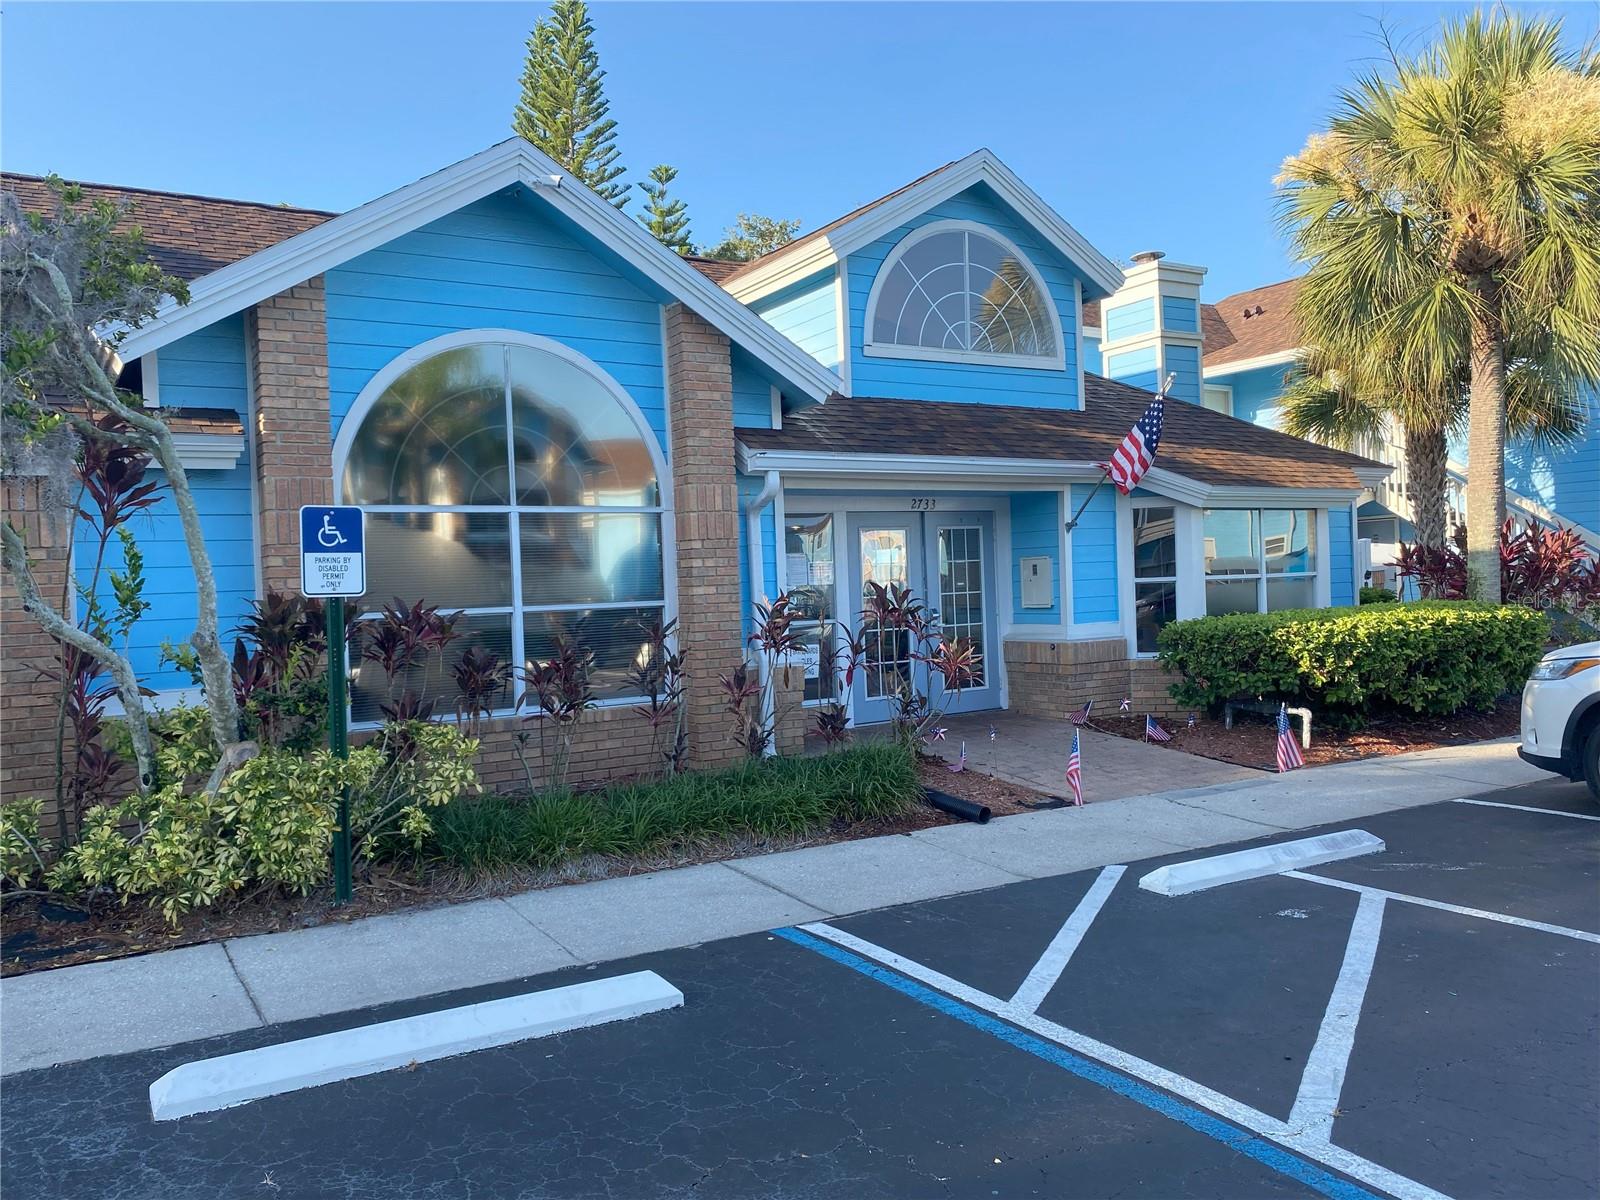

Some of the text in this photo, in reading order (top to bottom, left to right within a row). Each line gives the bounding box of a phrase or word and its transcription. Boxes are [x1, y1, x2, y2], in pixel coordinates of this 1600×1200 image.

[911, 498, 936, 510] 2733
[315, 556, 341, 564] PARKING
[318, 564, 349, 572] DISABLED
[322, 572, 345, 580] PERMIT
[325, 580, 341, 588] ONLY
